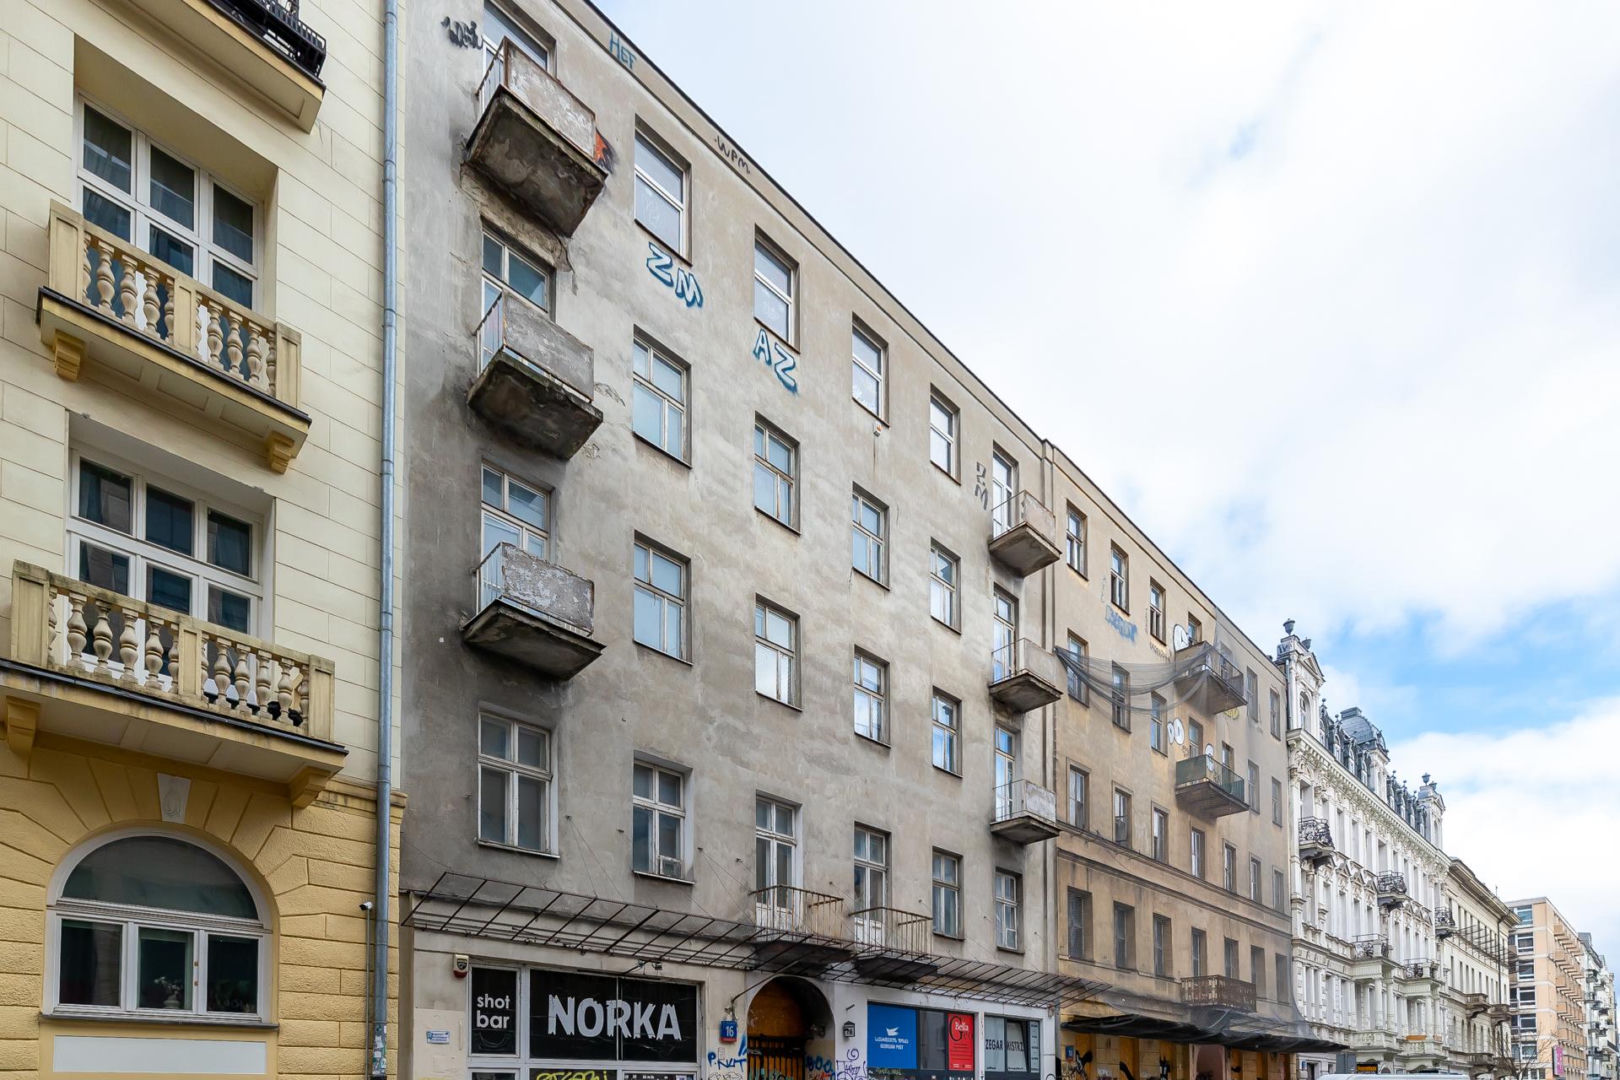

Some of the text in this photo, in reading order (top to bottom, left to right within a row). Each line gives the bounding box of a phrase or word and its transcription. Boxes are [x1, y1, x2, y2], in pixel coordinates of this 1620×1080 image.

[646, 242, 703, 308] ZM
[753, 329, 798, 393] AZ
[477, 993, 511, 1010] shot
[547, 994, 682, 1041] NORKA
[476, 1010, 510, 1030] bar
[726, 1025, 734, 1037] 16
